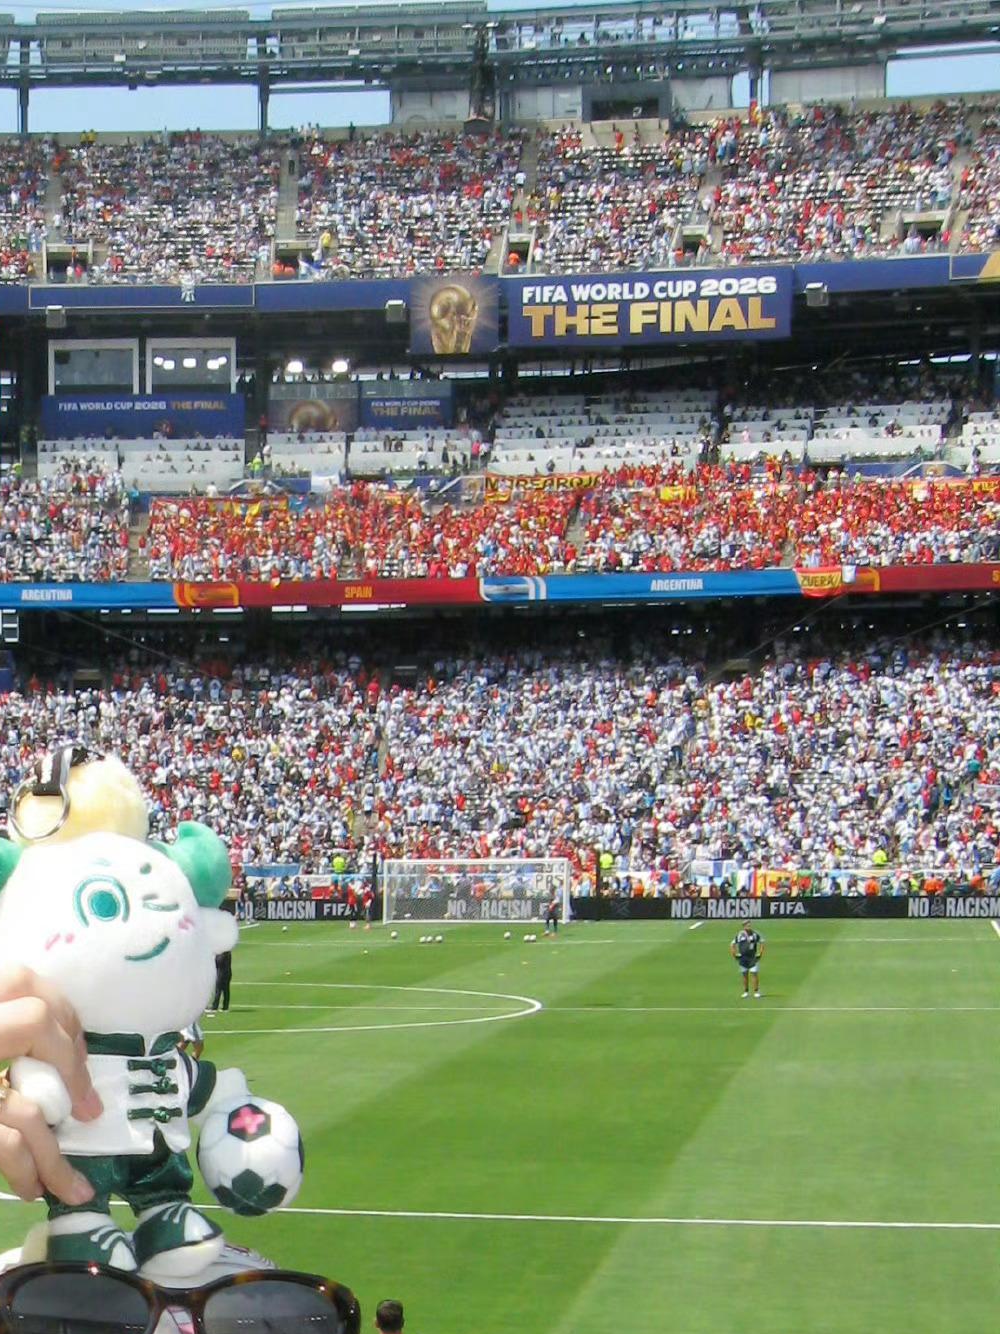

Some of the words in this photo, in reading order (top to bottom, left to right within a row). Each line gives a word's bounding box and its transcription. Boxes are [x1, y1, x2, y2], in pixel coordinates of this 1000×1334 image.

[522, 285, 568, 304] FIFA
[571, 281, 649, 301] WORLD
[653, 280, 697, 298] CUP
[700, 276, 777, 297] 2026
[522, 303, 619, 337] THE
[629, 296, 777, 335] FINAL
[344, 585, 373, 600] SPAIN
[650, 578, 704, 592] ARGENTINA
[267, 900, 316, 920] RACISM
[671, 899, 692, 918] NO
[707, 898, 762, 918] RACISM
[769, 901, 806, 915] FIFA
[908, 897, 930, 917] NO
[945, 897, 1000, 918] RACISM
